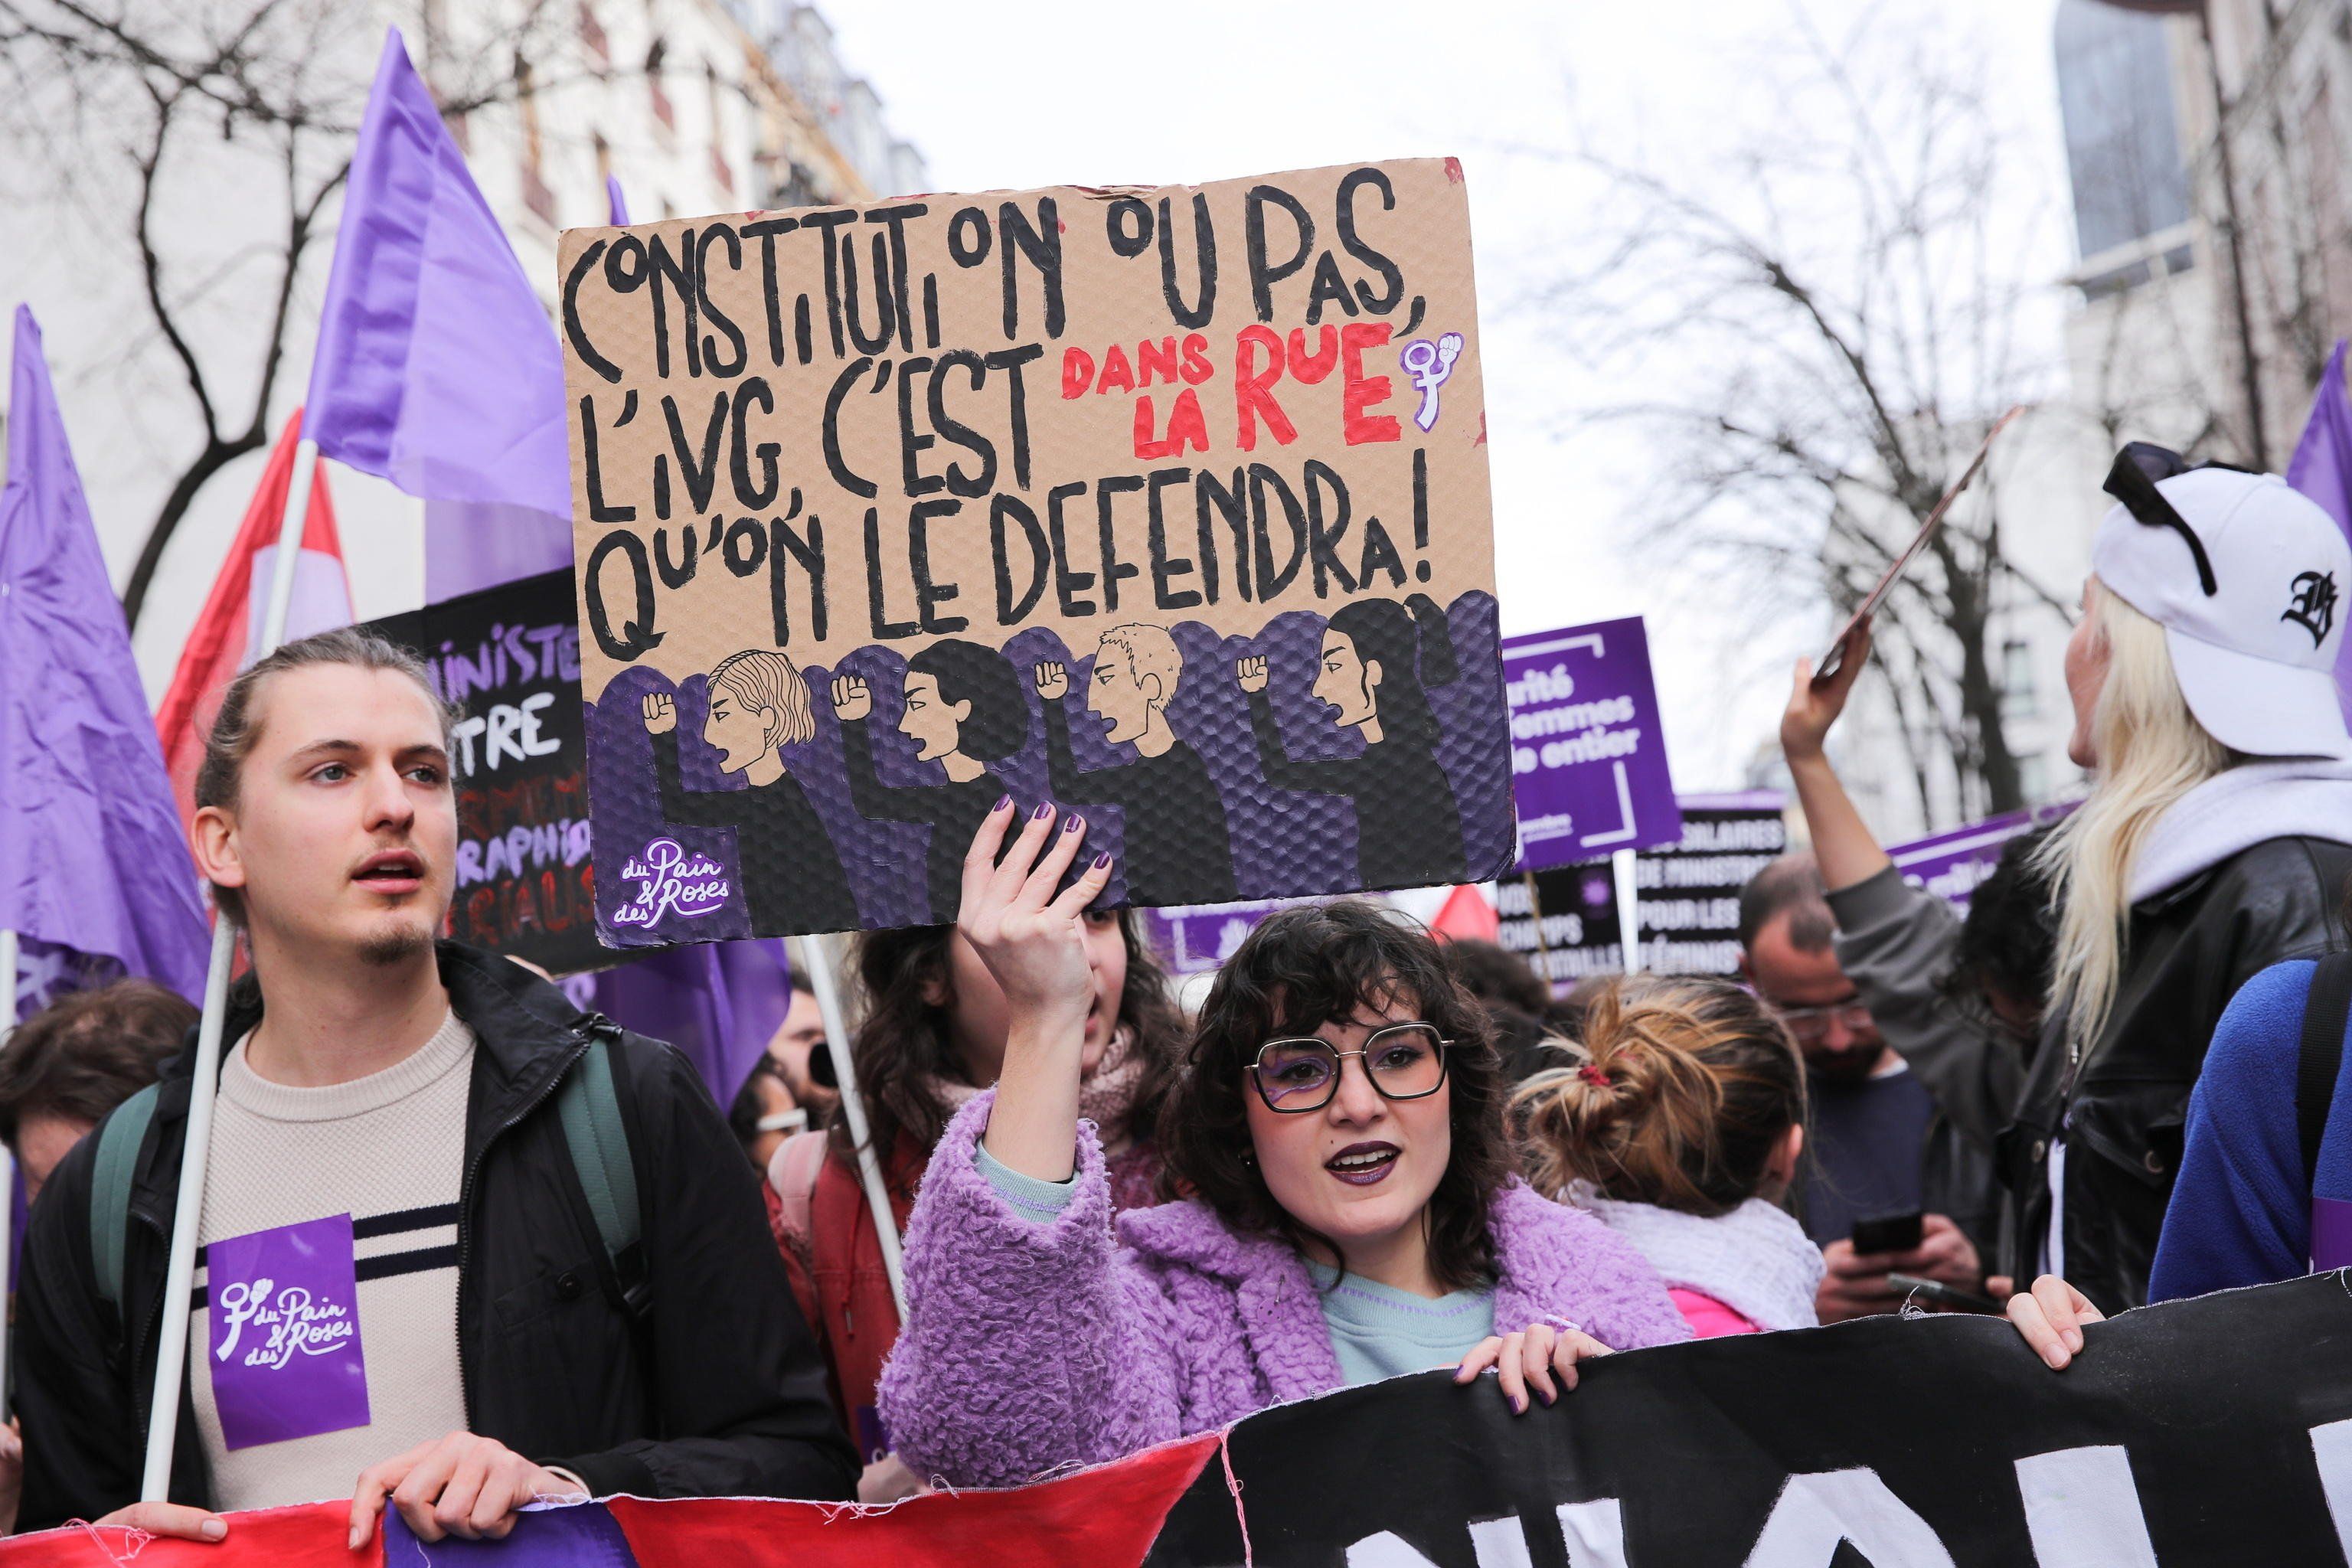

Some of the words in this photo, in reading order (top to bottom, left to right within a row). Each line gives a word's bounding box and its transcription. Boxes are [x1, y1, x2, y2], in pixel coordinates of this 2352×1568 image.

[563, 197, 1065, 383] CONSTITUTION
[1106, 192, 1217, 329] OU
[1245, 167, 1426, 338] PAS,
[1061, 333, 1214, 399] DANS
[1236, 322, 1402, 451] RUE
[822, 343, 1044, 498] C'EST
[1133, 388, 1209, 459] LA
[585, 514, 827, 662] QU'ON
[864, 499, 969, 639] LE
[1540, 725, 1641, 769] entier
[622, 859, 651, 880] du
[647, 840, 721, 897] Pain
[613, 903, 649, 923] des
[641, 878, 729, 929] Roses
[244, 1348, 279, 1366] des
[270, 1321, 353, 1370] Roses
[253, 1306, 281, 1326] du
[277, 1287, 347, 1339] Pain
